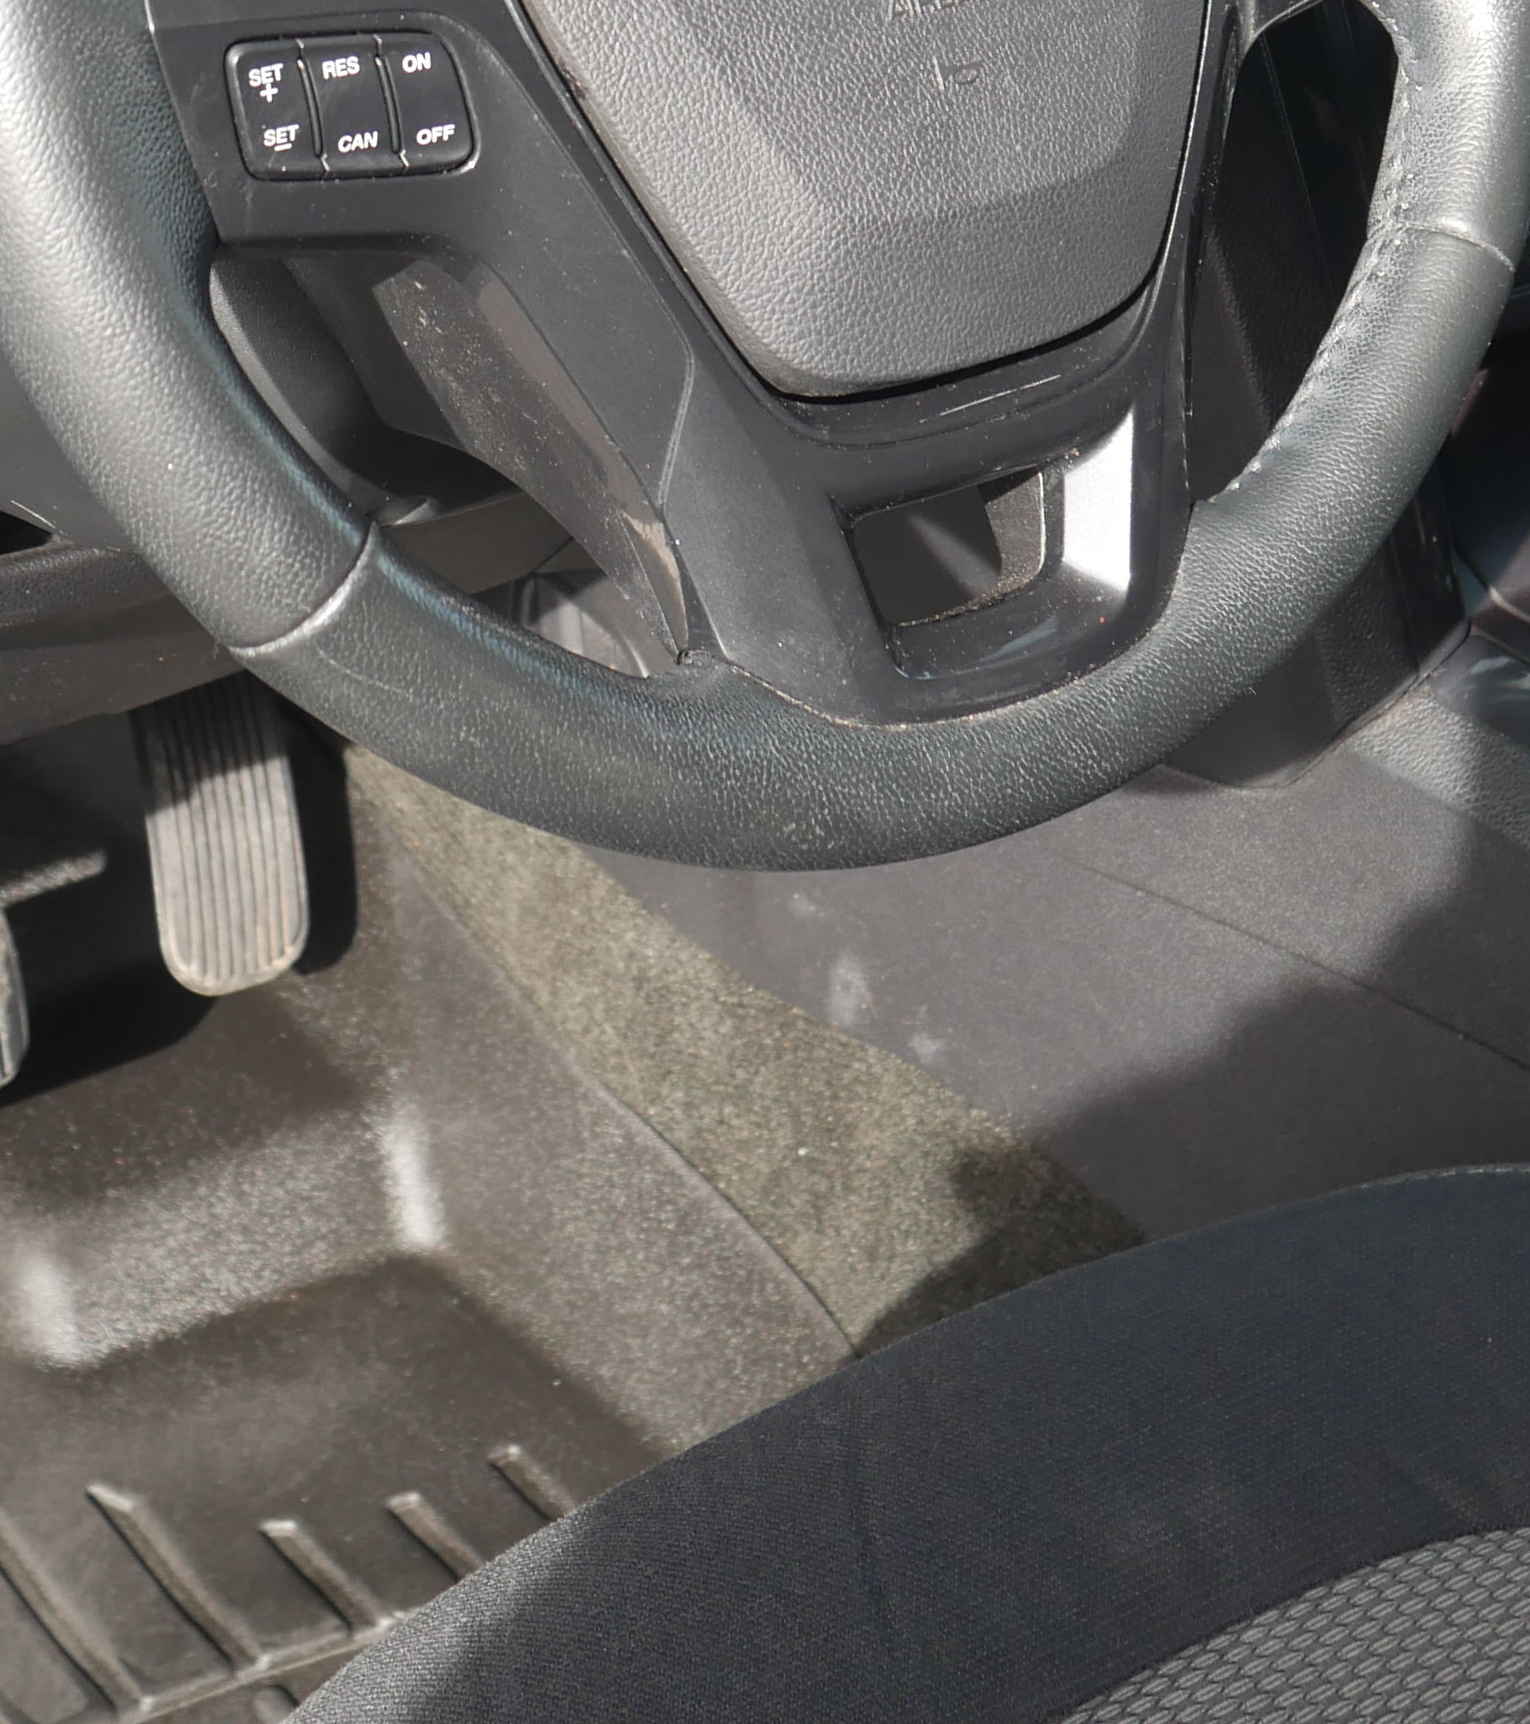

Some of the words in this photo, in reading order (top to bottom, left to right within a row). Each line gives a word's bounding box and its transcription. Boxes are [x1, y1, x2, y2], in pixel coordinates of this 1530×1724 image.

[322, 55, 360, 79] RES
[402, 53, 431, 73] ON
[248, 63, 284, 86] SET
[263, 124, 300, 147] SET
[337, 131, 379, 153] CAN
[416, 124, 455, 146] OFF
